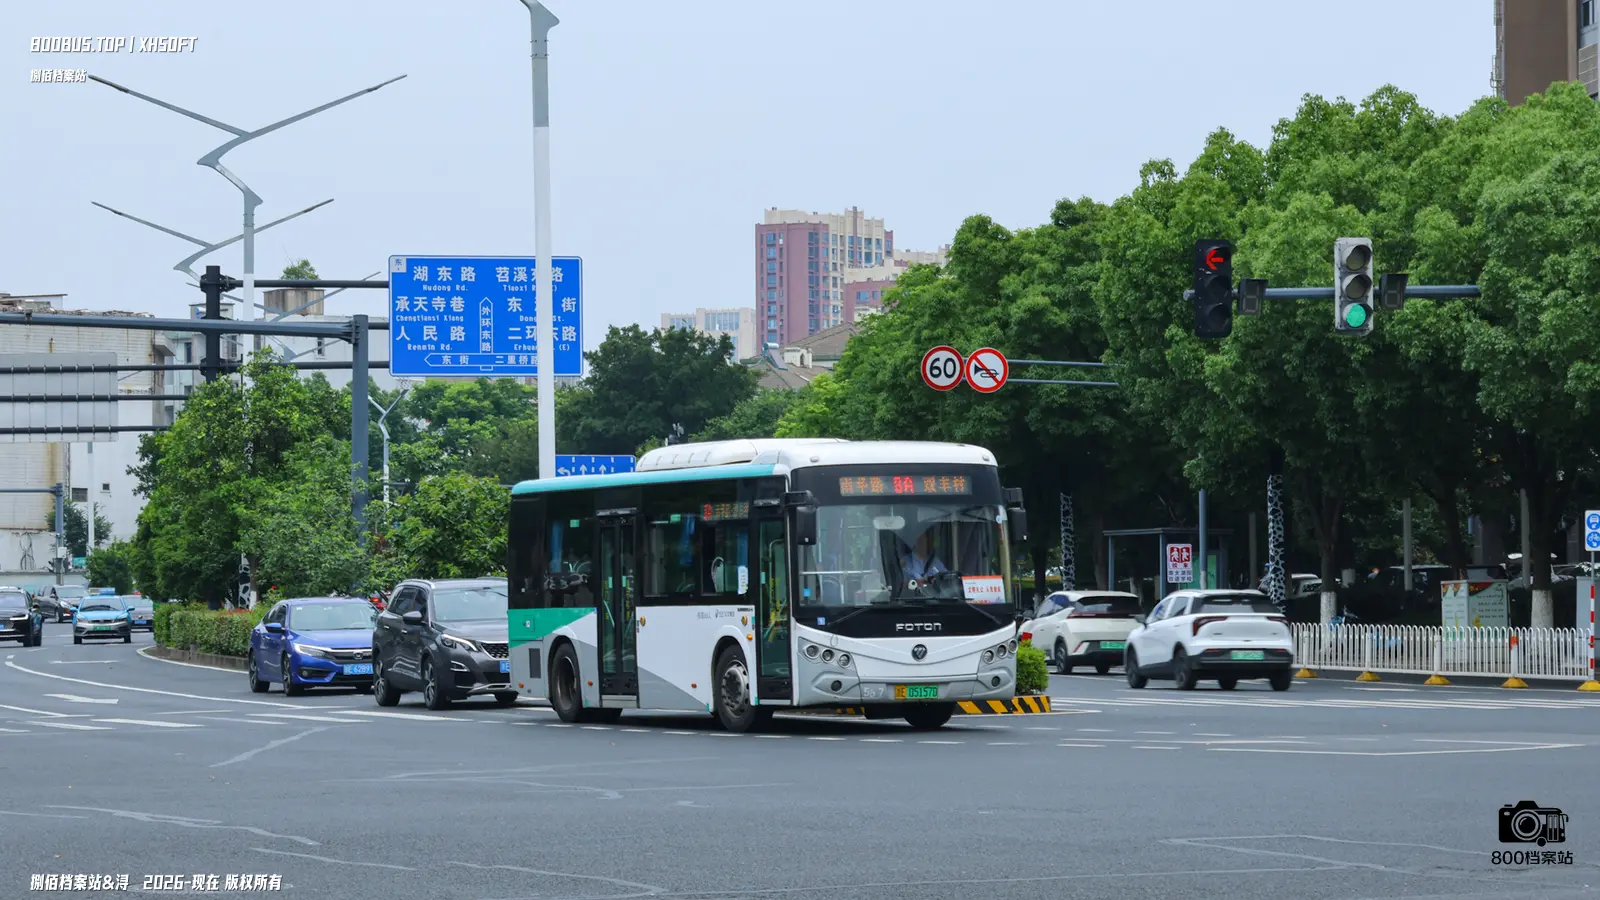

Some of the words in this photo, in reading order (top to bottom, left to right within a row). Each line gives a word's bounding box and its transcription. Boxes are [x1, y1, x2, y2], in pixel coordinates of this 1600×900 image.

[413, 266, 476, 282] 湖东路
[422, 284, 451, 292] Hudong
[455, 284, 469, 292] Rd.
[503, 284, 528, 292] Tiaoxi
[395, 296, 465, 312] 承天寺巷
[507, 297, 576, 313] 东街
[396, 314, 440, 323] Chengtiansi
[443, 314, 464, 323] Xiang
[396, 326, 466, 341] 人民路
[481, 306, 492, 352] 外环东路
[407, 343, 436, 351] Renmin
[440, 343, 453, 351] Rd.
[559, 343, 570, 351] (E)
[441, 355, 469, 365] 东街
[929, 357, 957, 379] 60
[895, 622, 942, 632] FOTON
